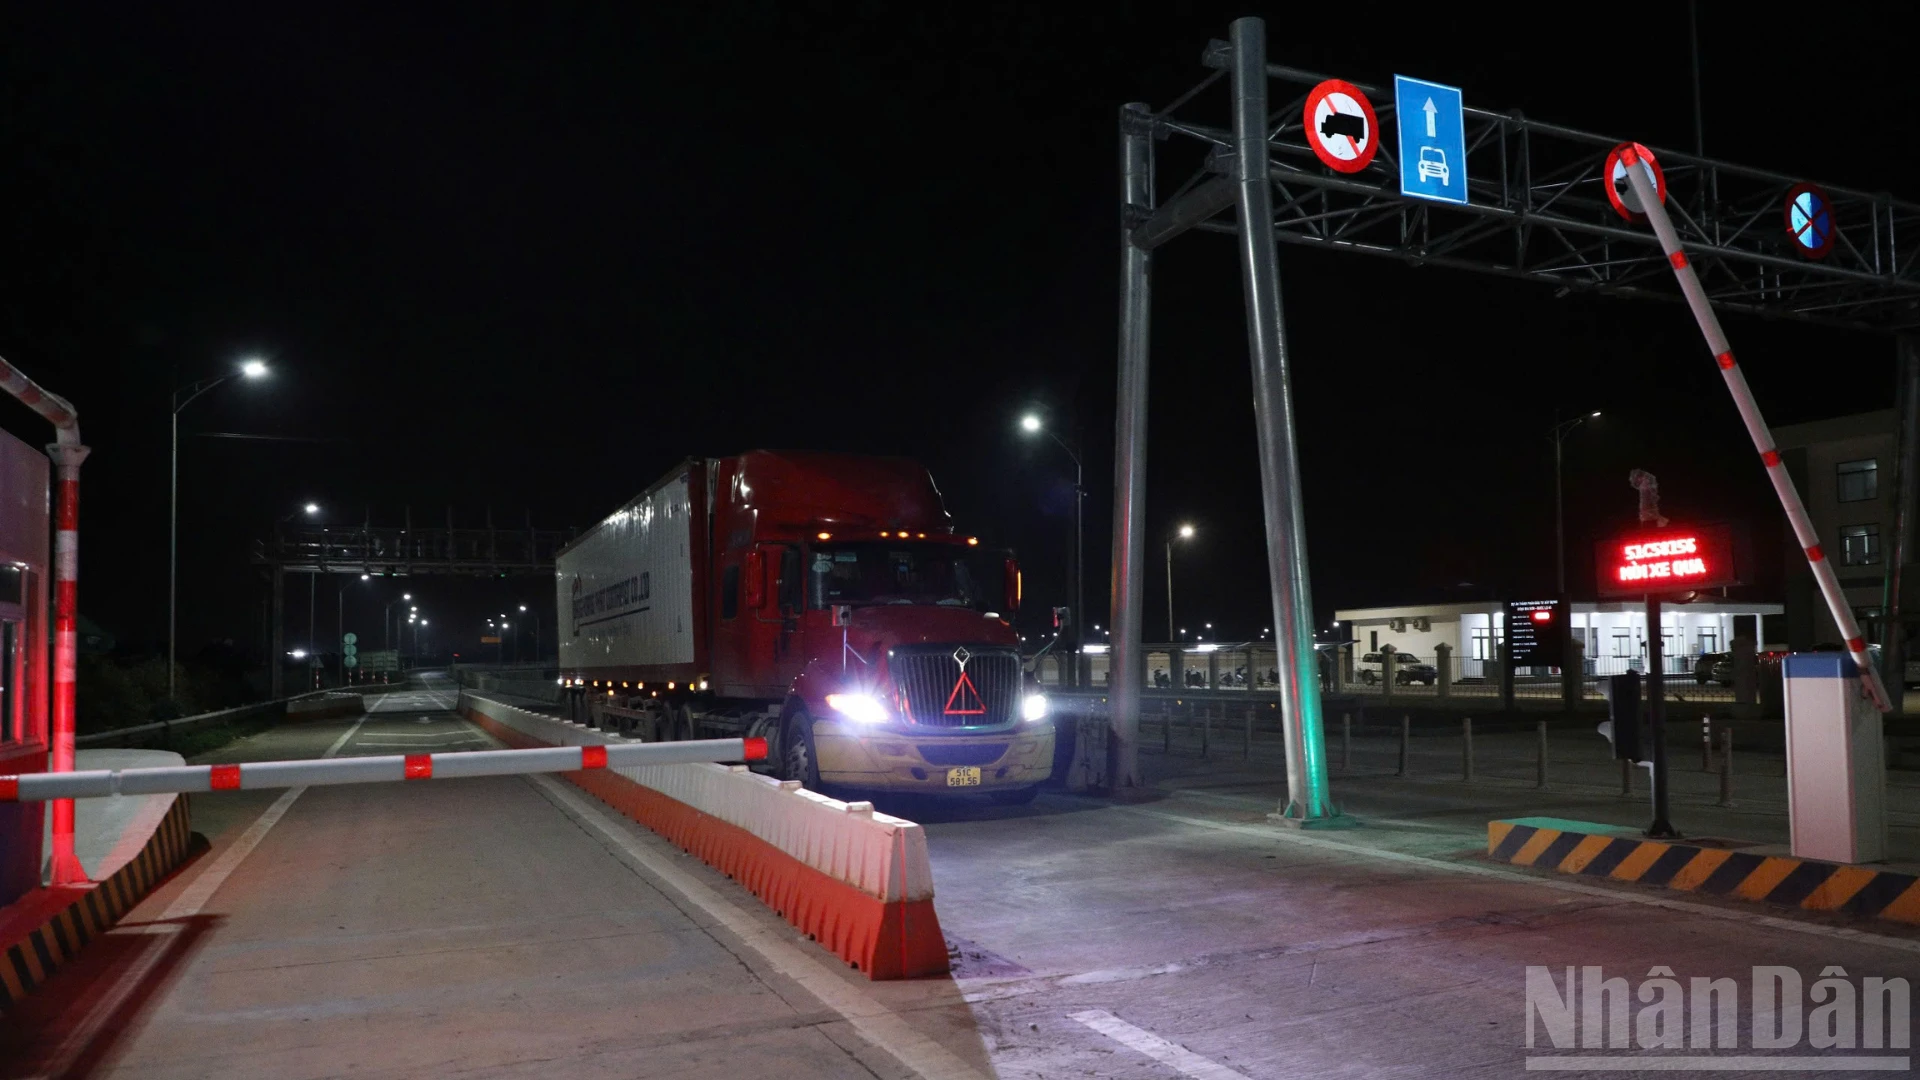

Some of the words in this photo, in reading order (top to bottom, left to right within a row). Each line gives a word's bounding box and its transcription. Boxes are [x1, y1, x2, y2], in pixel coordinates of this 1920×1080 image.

[1625, 538, 1696, 560] 51C58156
[1649, 562, 1670, 578] XE
[1672, 558, 1706, 576] QUA
